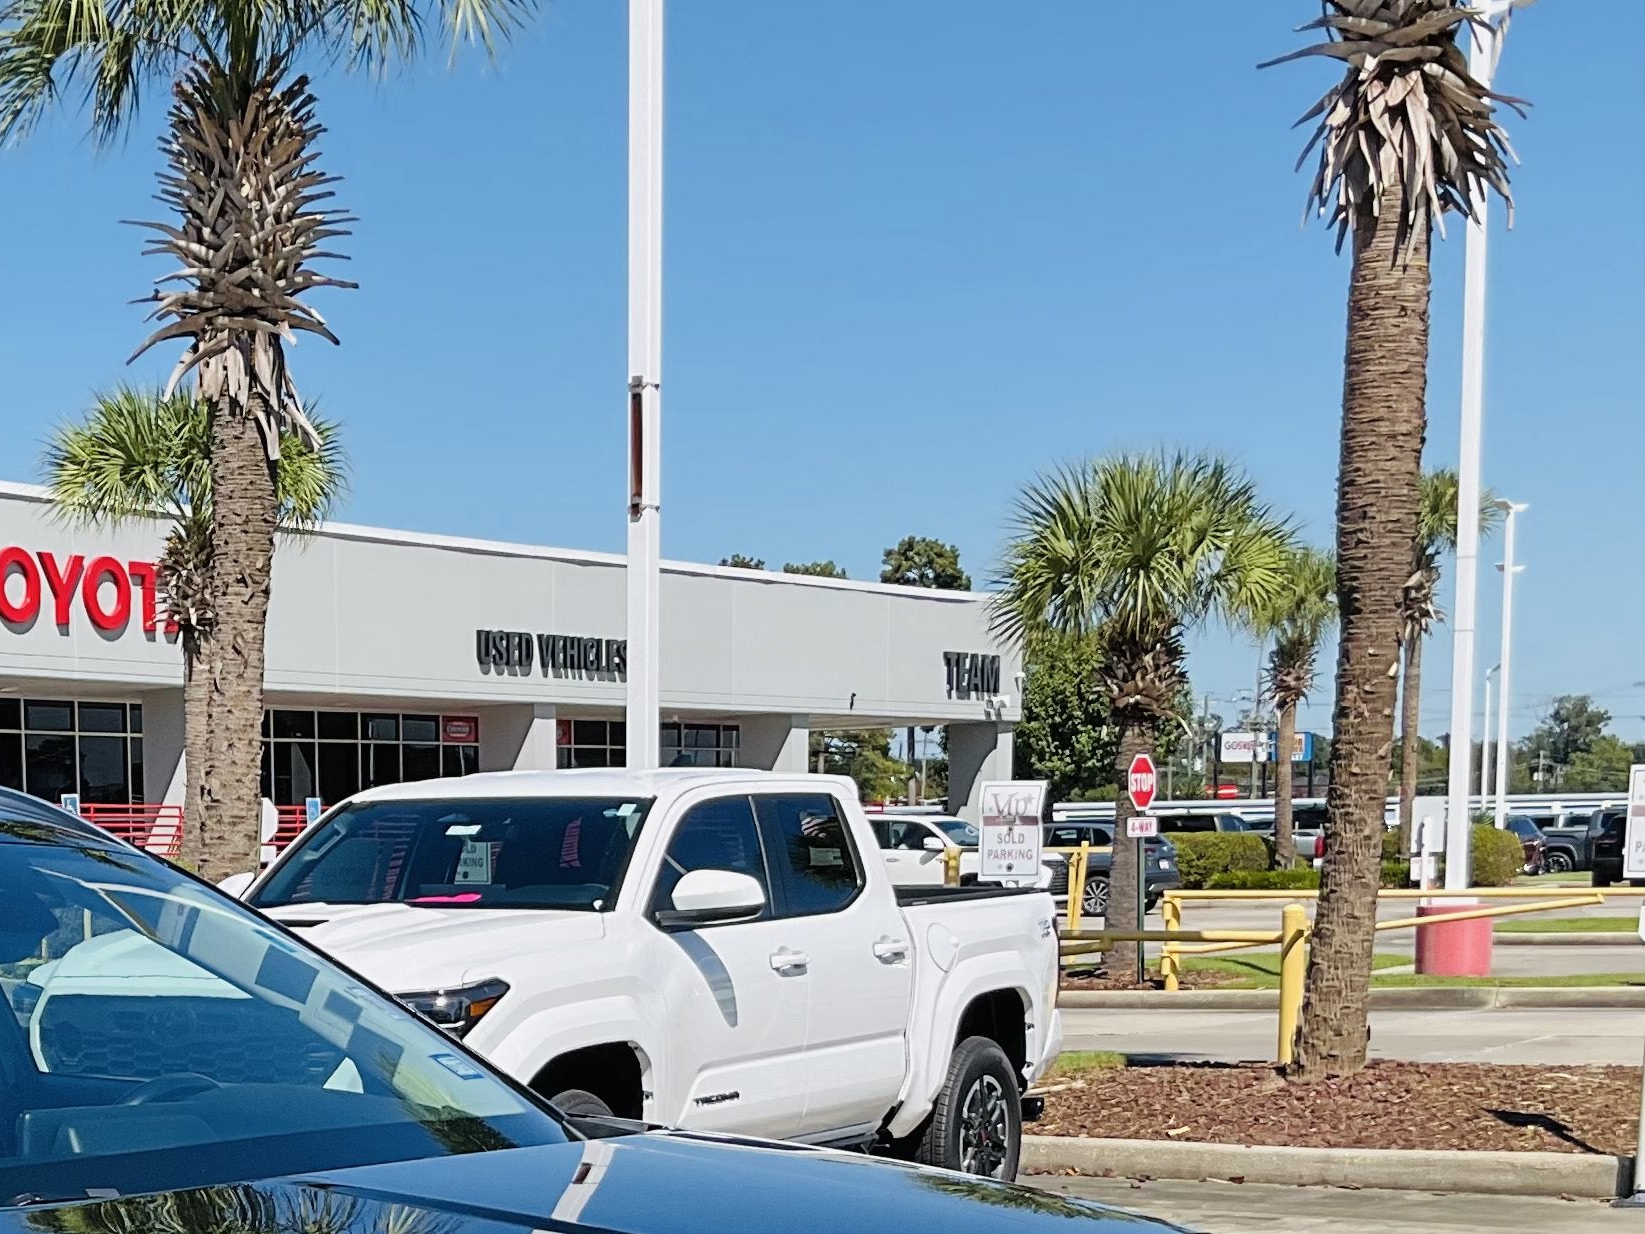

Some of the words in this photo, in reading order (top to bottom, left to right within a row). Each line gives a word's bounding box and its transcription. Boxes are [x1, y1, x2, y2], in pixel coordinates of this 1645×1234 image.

[476, 629, 533, 667] USED
[537, 634, 628, 674] VEHICLES
[942, 651, 1001, 694] TEAM
[1131, 773, 1153, 792] STOP
[1130, 821, 1153, 833] 4-WAY
[996, 833, 1025, 844] SOLD
[987, 849, 1033, 860] PARKING
